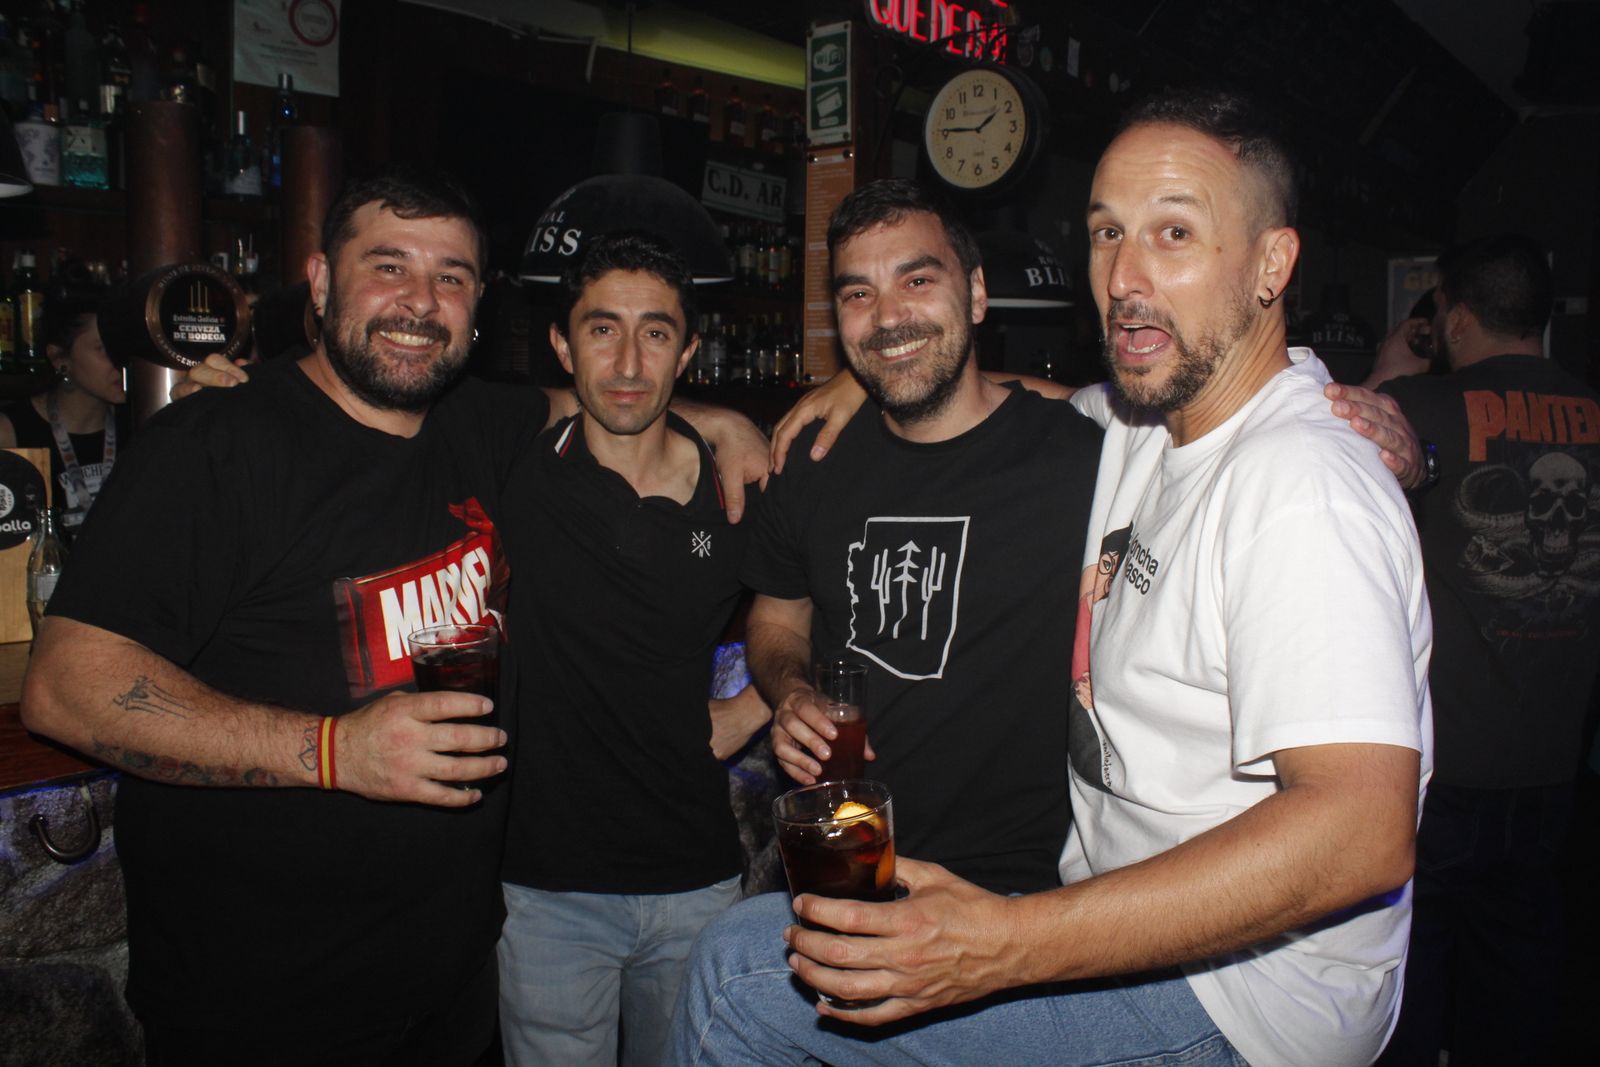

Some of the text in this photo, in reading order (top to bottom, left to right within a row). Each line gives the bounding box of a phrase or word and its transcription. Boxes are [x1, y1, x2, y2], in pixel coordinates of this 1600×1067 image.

[973, 85, 984, 97] 12
[959, 92, 967, 104] 11
[1004, 101, 1013, 113] 2
[946, 108, 956, 120] 10
[1009, 121, 1017, 133] 3
[942, 129, 949, 140] 9
[946, 147, 953, 159] 8
[1004, 143, 1012, 153] 4
[958, 160, 965, 172] 7
[992, 157, 999, 169] 5
[974, 163, 982, 176] 6
[178, 324, 221, 333] CERVEZA
[173, 332, 226, 341] DE BODEGA
[1313, 330, 1365, 348] BLISS
